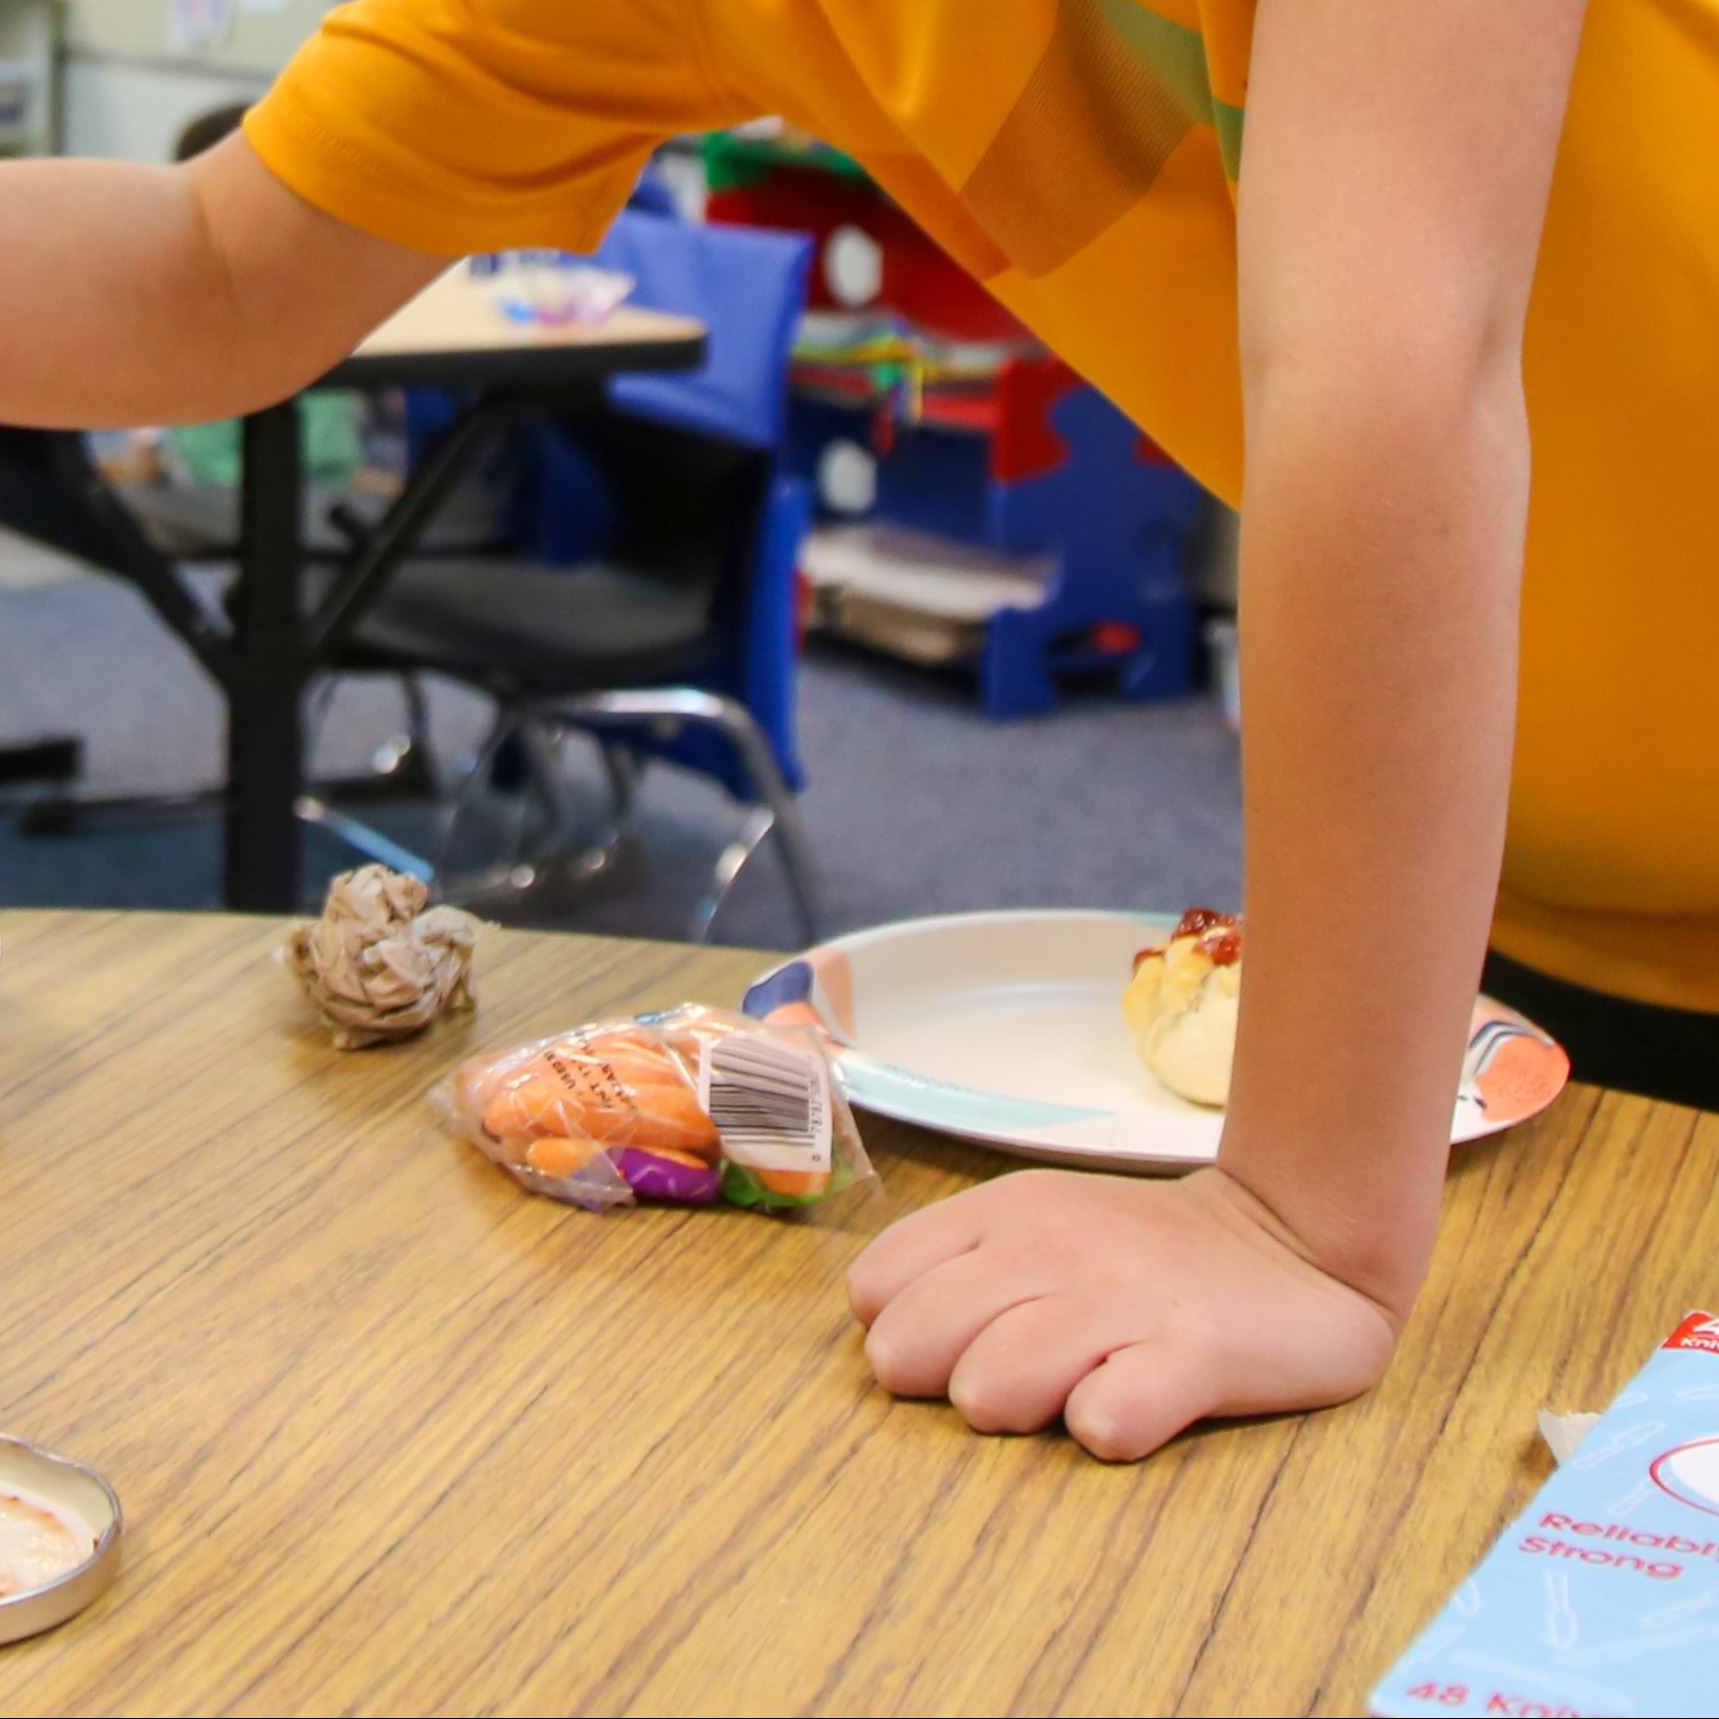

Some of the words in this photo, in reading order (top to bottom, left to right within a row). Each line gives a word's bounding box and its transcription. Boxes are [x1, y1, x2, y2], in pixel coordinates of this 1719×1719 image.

[1518, 1535, 1686, 1581] Strong
[1539, 1512, 1719, 1565] Reliabl
[1405, 1682, 1470, 1708] 48
